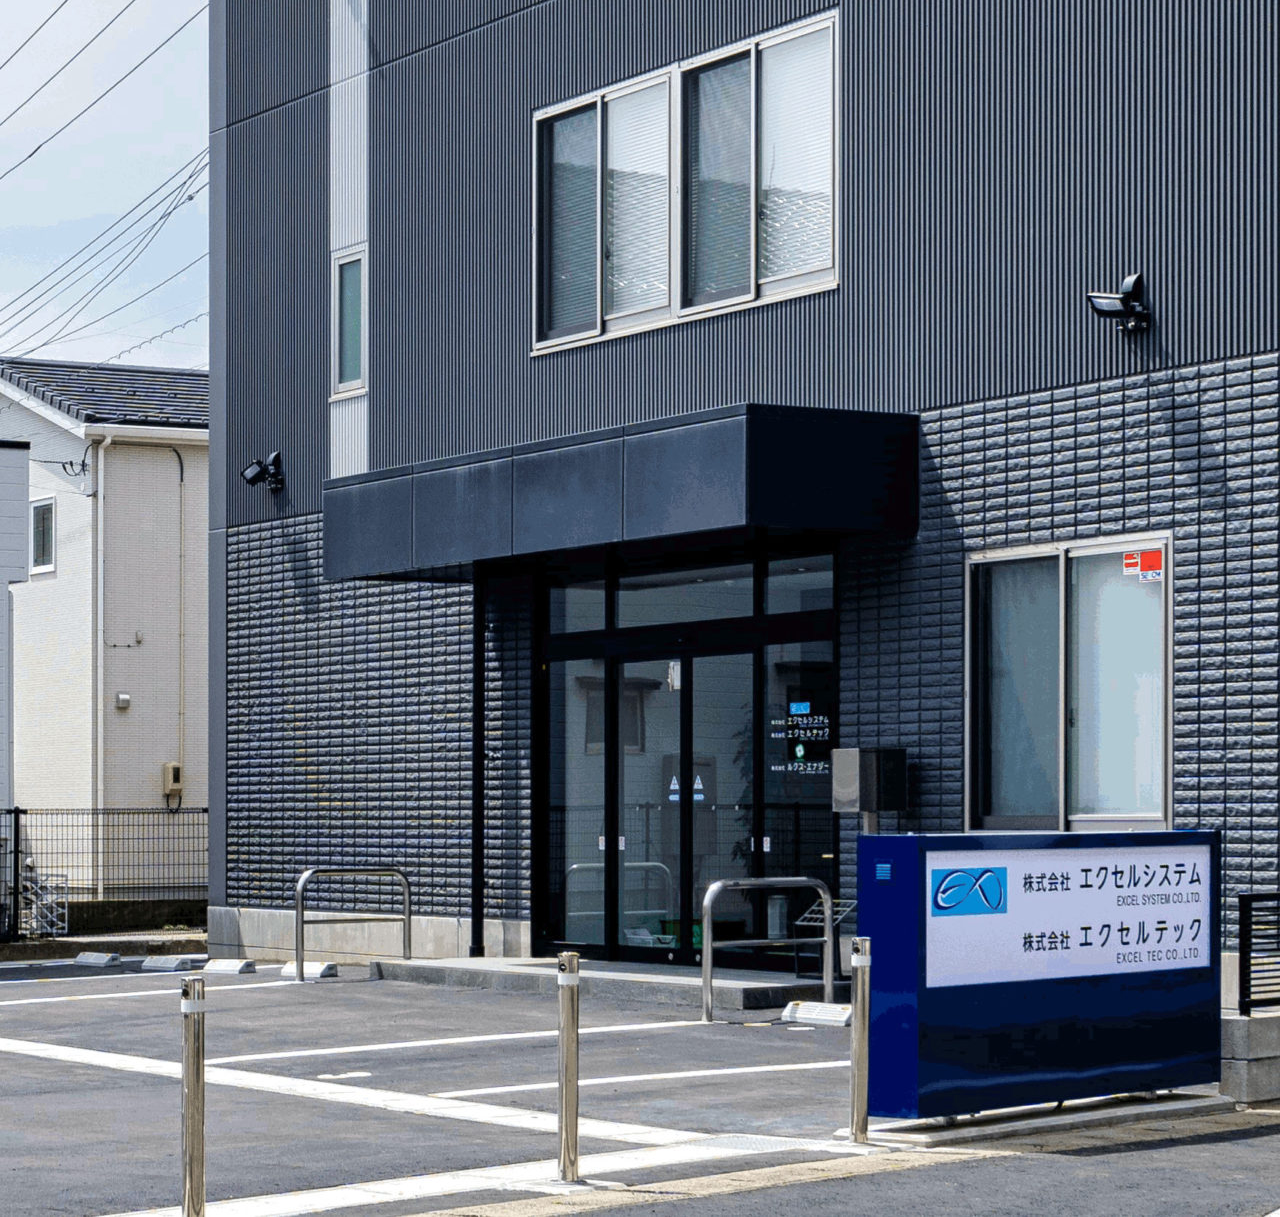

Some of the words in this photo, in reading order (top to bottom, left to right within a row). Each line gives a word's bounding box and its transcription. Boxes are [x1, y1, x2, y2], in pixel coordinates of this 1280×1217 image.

[1023, 872, 1071, 893] 株式会社
[1080, 863, 1202, 890] エクセルシステム
[1116, 895, 1140, 906] EXCEL
[1141, 893, 1171, 905] SYSTEM
[1023, 931, 1071, 953] 株式会社
[1079, 919, 1201, 947] エクセルテック
[1116, 951, 1143, 963] EXCEL
[1147, 949, 1163, 961] TEC
